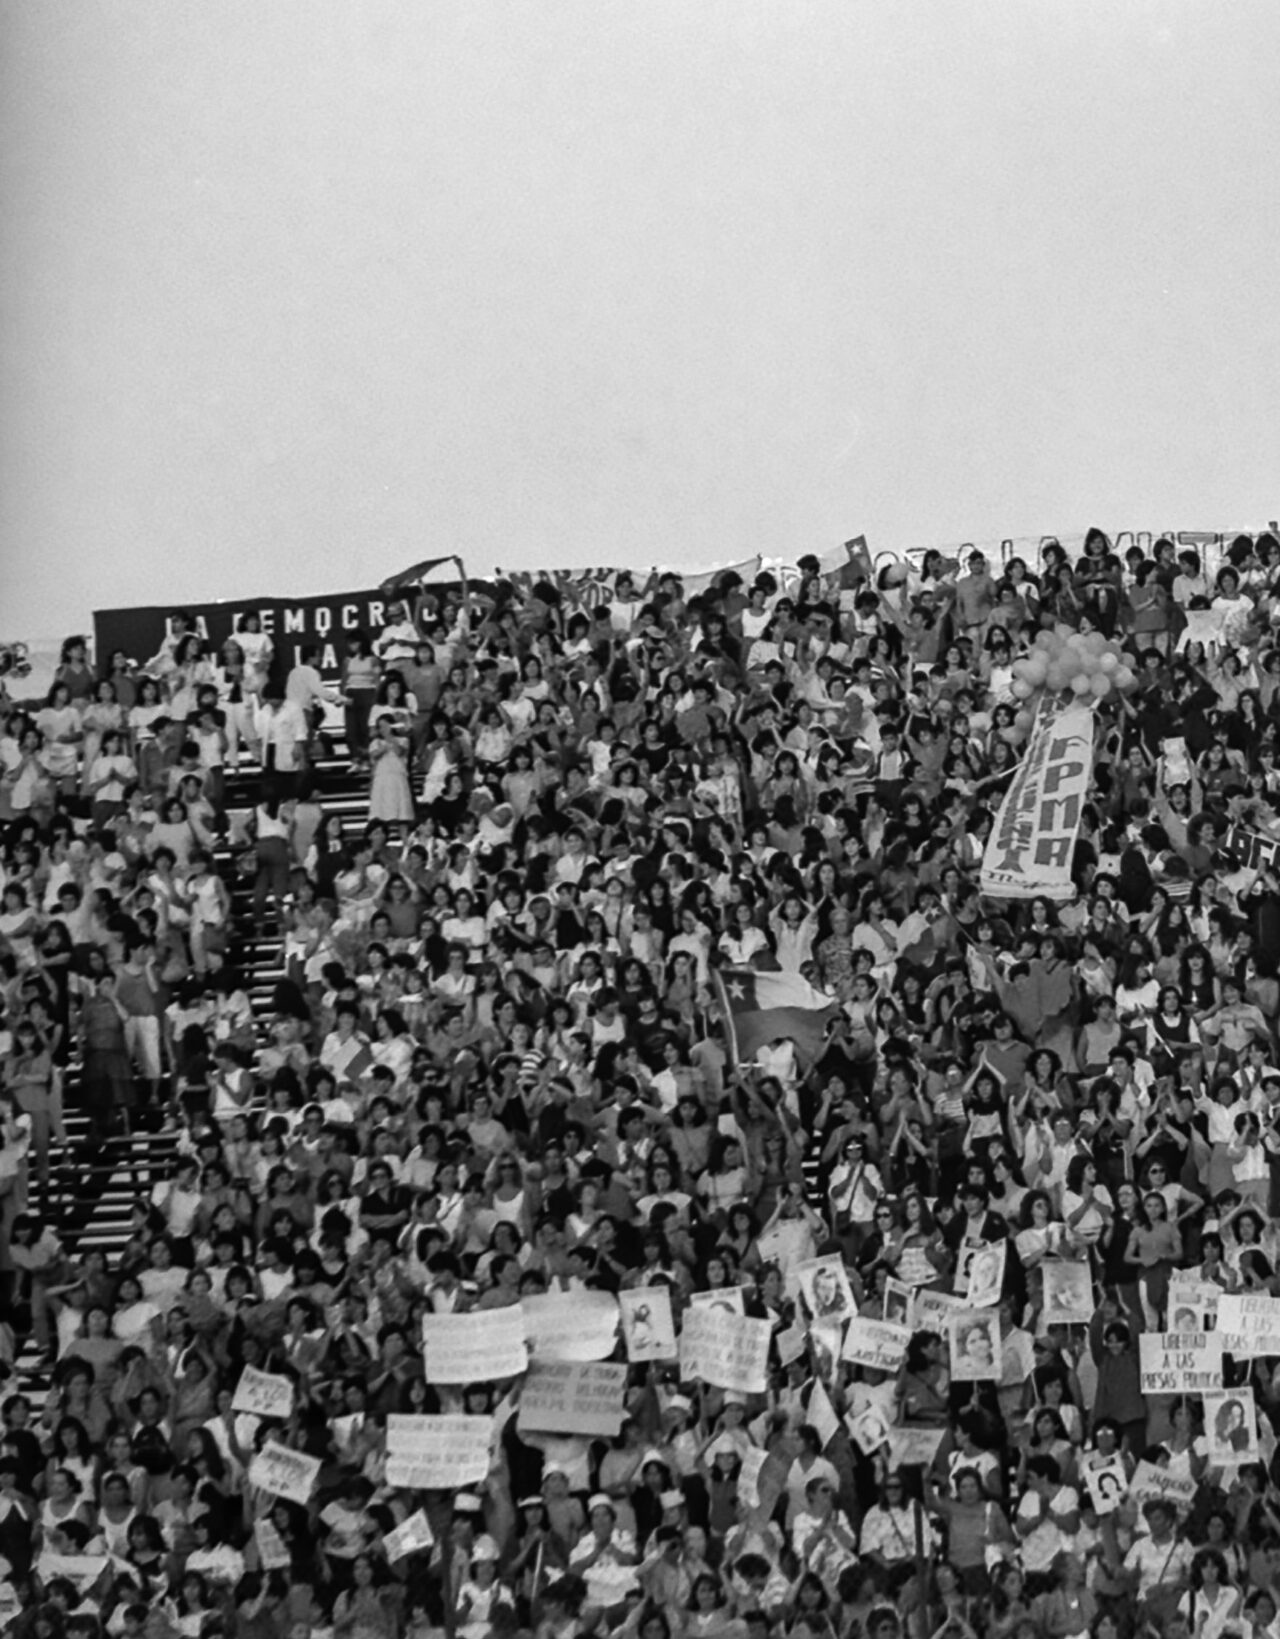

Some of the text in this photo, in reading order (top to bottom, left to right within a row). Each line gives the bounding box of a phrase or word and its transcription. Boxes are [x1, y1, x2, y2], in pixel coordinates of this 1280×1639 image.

[1162, 1333, 1206, 1350] LIBERTAD
[1162, 1351, 1195, 1369] A LAS
[1142, 1372, 1177, 1389] PRESAS
